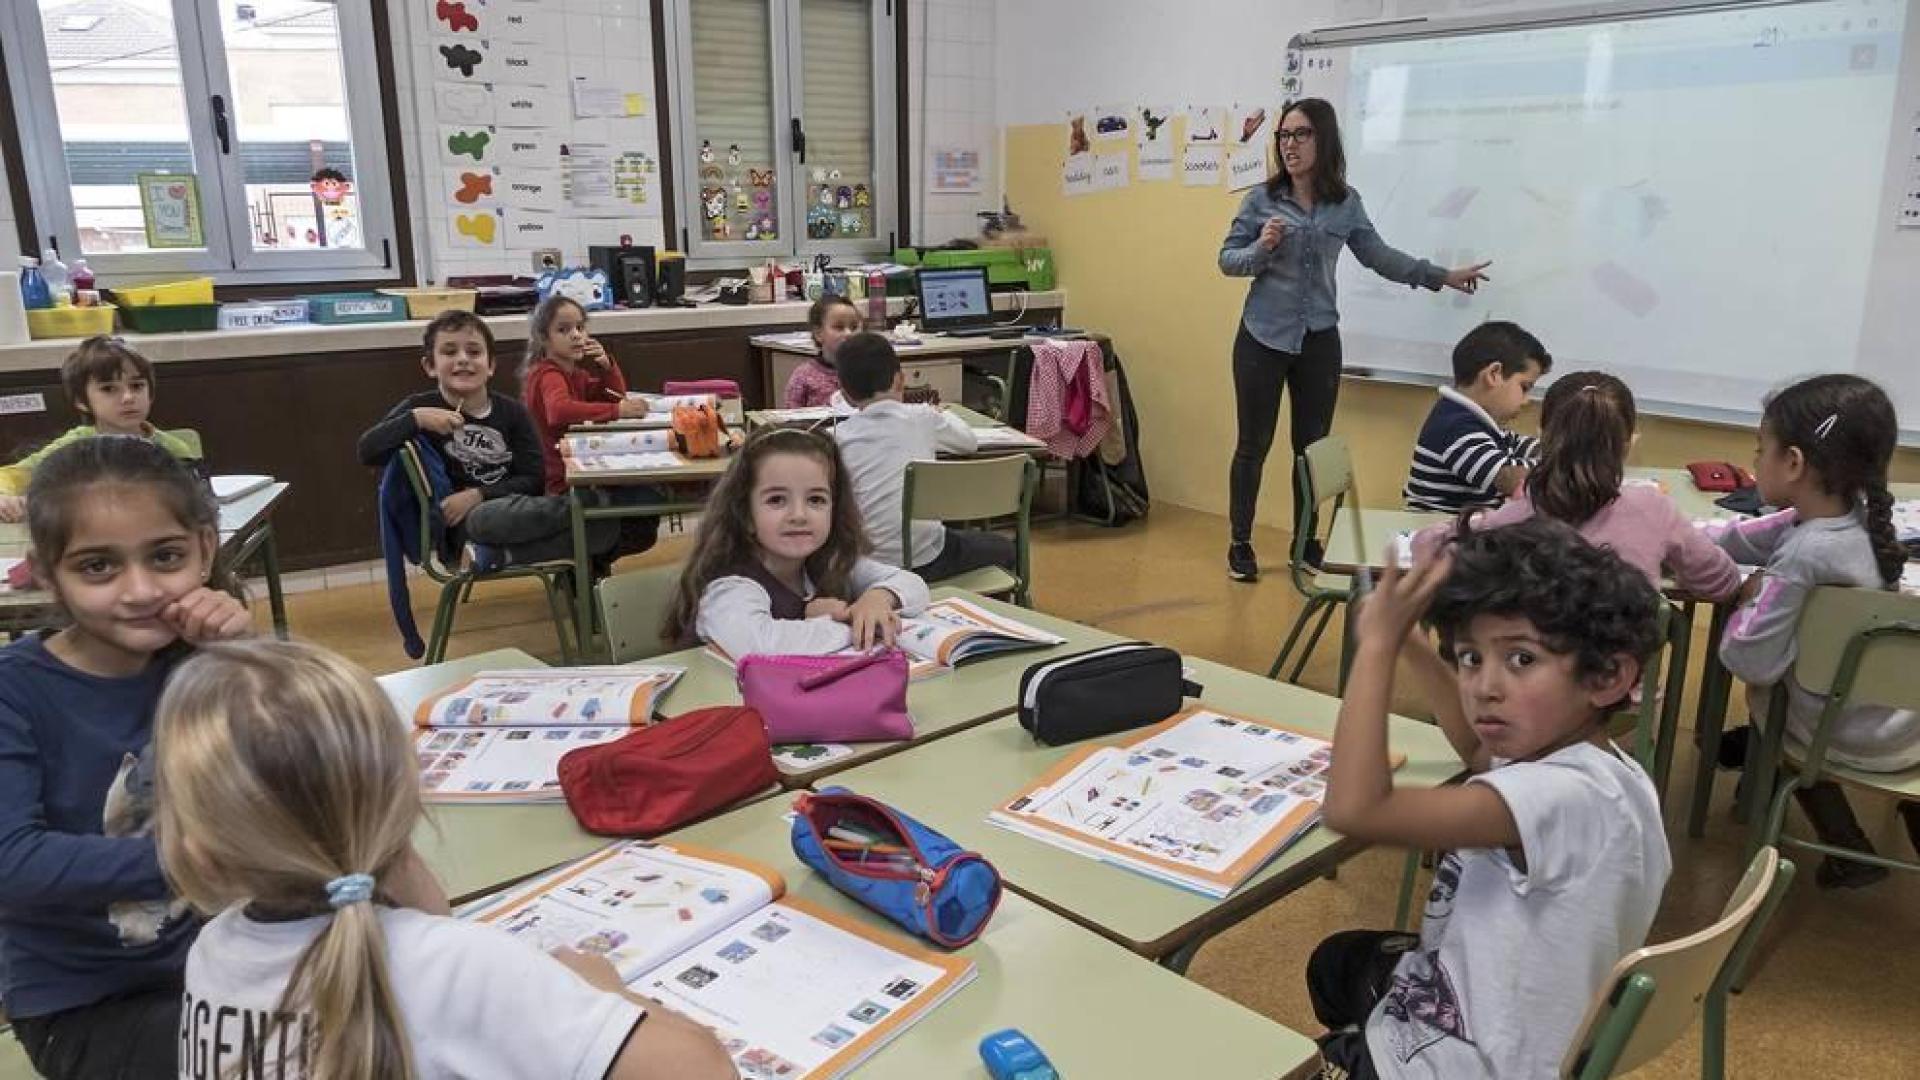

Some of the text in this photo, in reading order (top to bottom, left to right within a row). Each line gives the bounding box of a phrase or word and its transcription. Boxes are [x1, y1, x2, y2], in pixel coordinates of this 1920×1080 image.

[507, 15, 523, 24] red
[505, 57, 529, 67] black
[511, 100, 533, 109] white
[511, 143, 537, 152] green
[511, 183, 542, 194] orange
[517, 222, 544, 233] yellow
